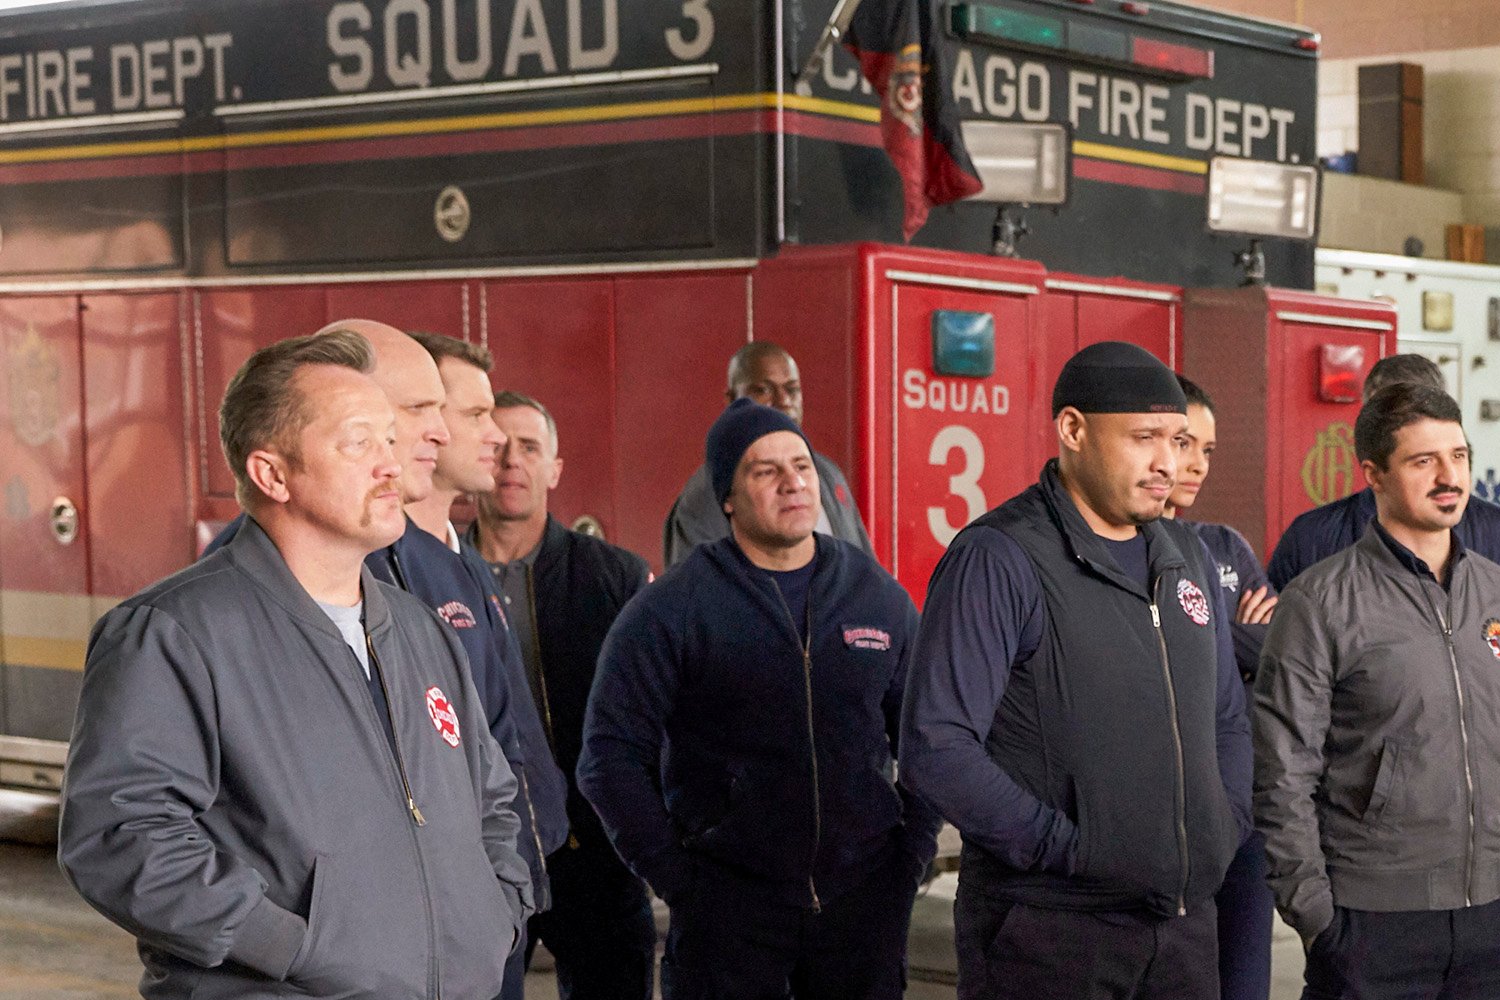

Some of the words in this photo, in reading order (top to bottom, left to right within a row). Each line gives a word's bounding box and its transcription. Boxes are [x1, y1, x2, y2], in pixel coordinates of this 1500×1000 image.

[0, 45, 96, 120] FIRE
[109, 32, 244, 111] DEPT.
[326, 0, 620, 91] SQUAD
[665, 0, 715, 62] 3
[822, 43, 1050, 122] CAGO
[1068, 70, 1171, 144] FIRE
[1185, 92, 1300, 164] DEPT.
[926, 424, 988, 550] 3
